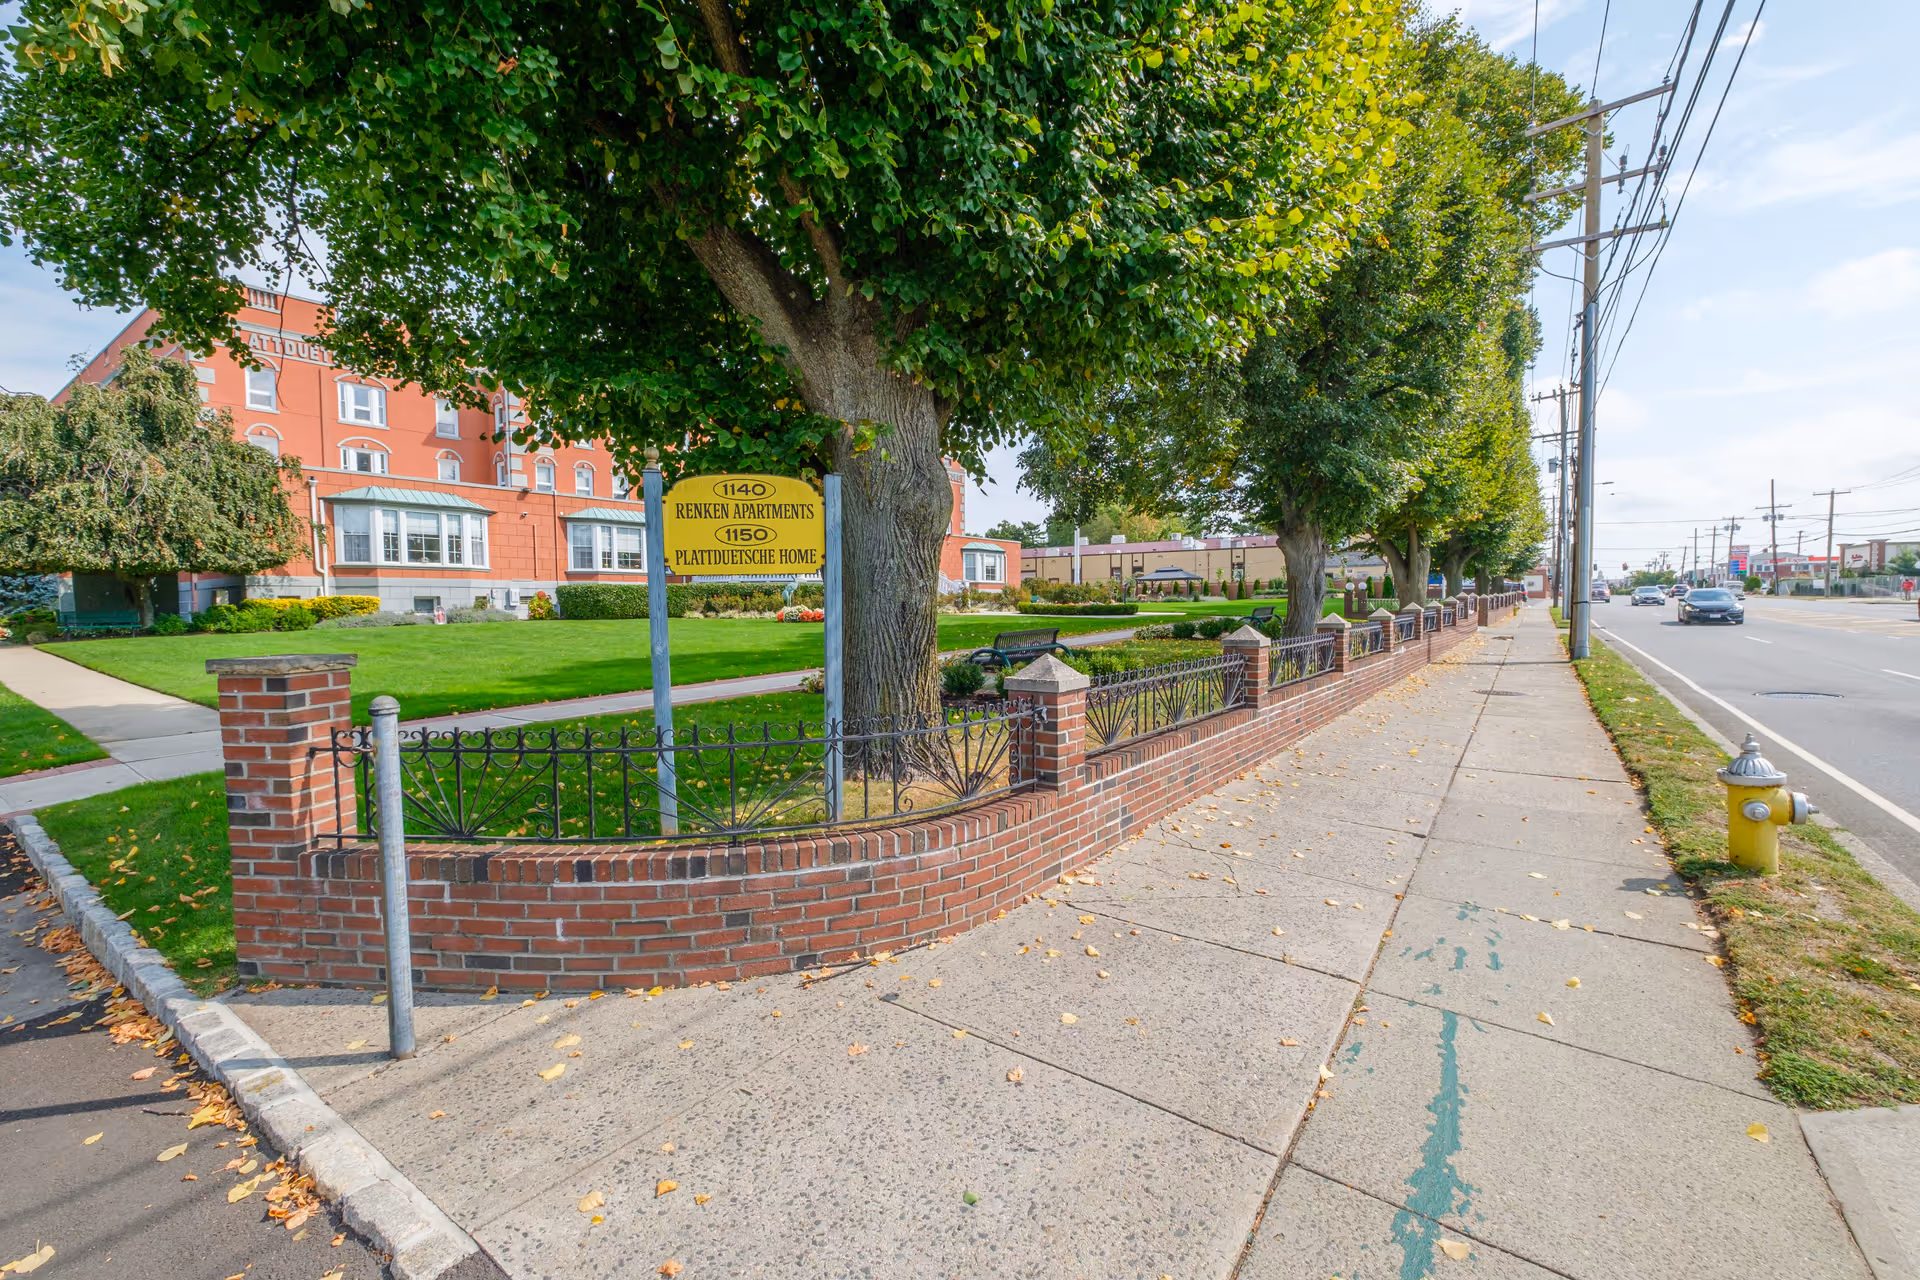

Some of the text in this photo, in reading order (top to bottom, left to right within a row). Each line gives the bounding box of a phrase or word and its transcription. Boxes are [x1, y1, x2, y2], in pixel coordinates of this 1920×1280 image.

[723, 483, 766, 496] 1140
[675, 503, 814, 519] RENKEN APARTMENTS
[725, 528, 768, 542] 1150
[675, 548, 817, 565] PLATTDUETSCHE HOME
